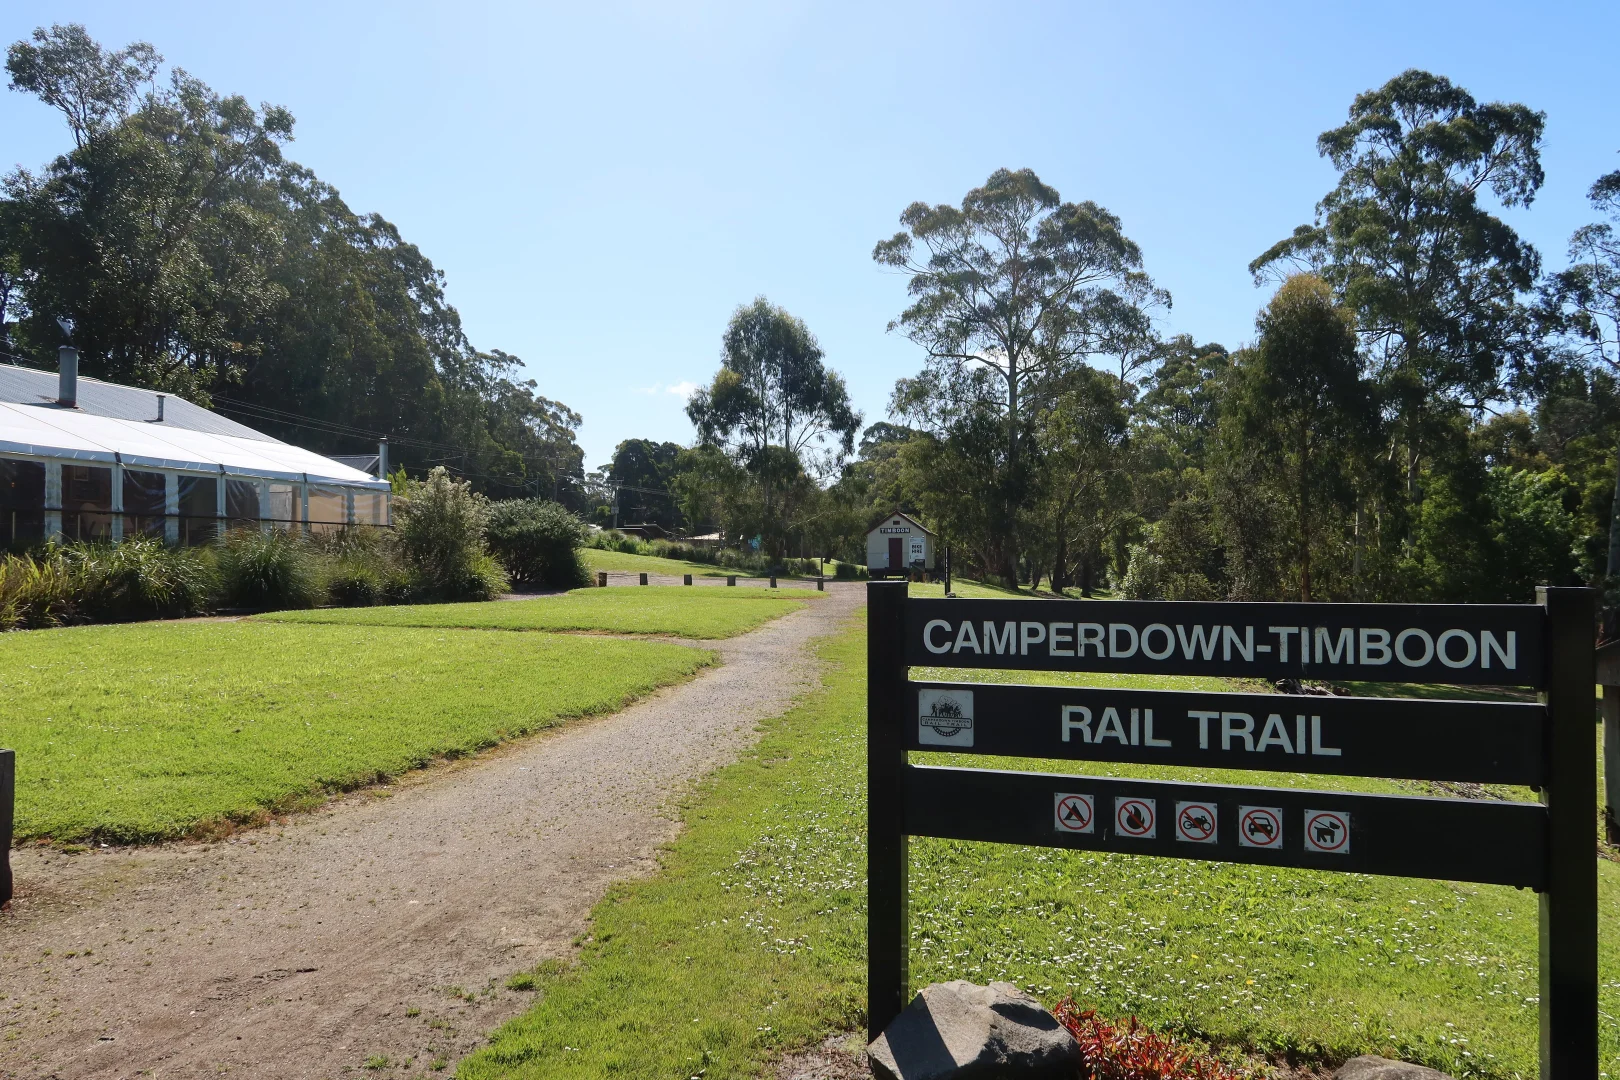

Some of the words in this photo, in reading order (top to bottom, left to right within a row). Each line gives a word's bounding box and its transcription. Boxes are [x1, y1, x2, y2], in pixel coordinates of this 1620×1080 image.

[923, 619, 1516, 670] CAMPERDOWN-TIMBOON
[1061, 705, 1172, 747] RAIL
[1187, 710, 1342, 756] TRAIL
